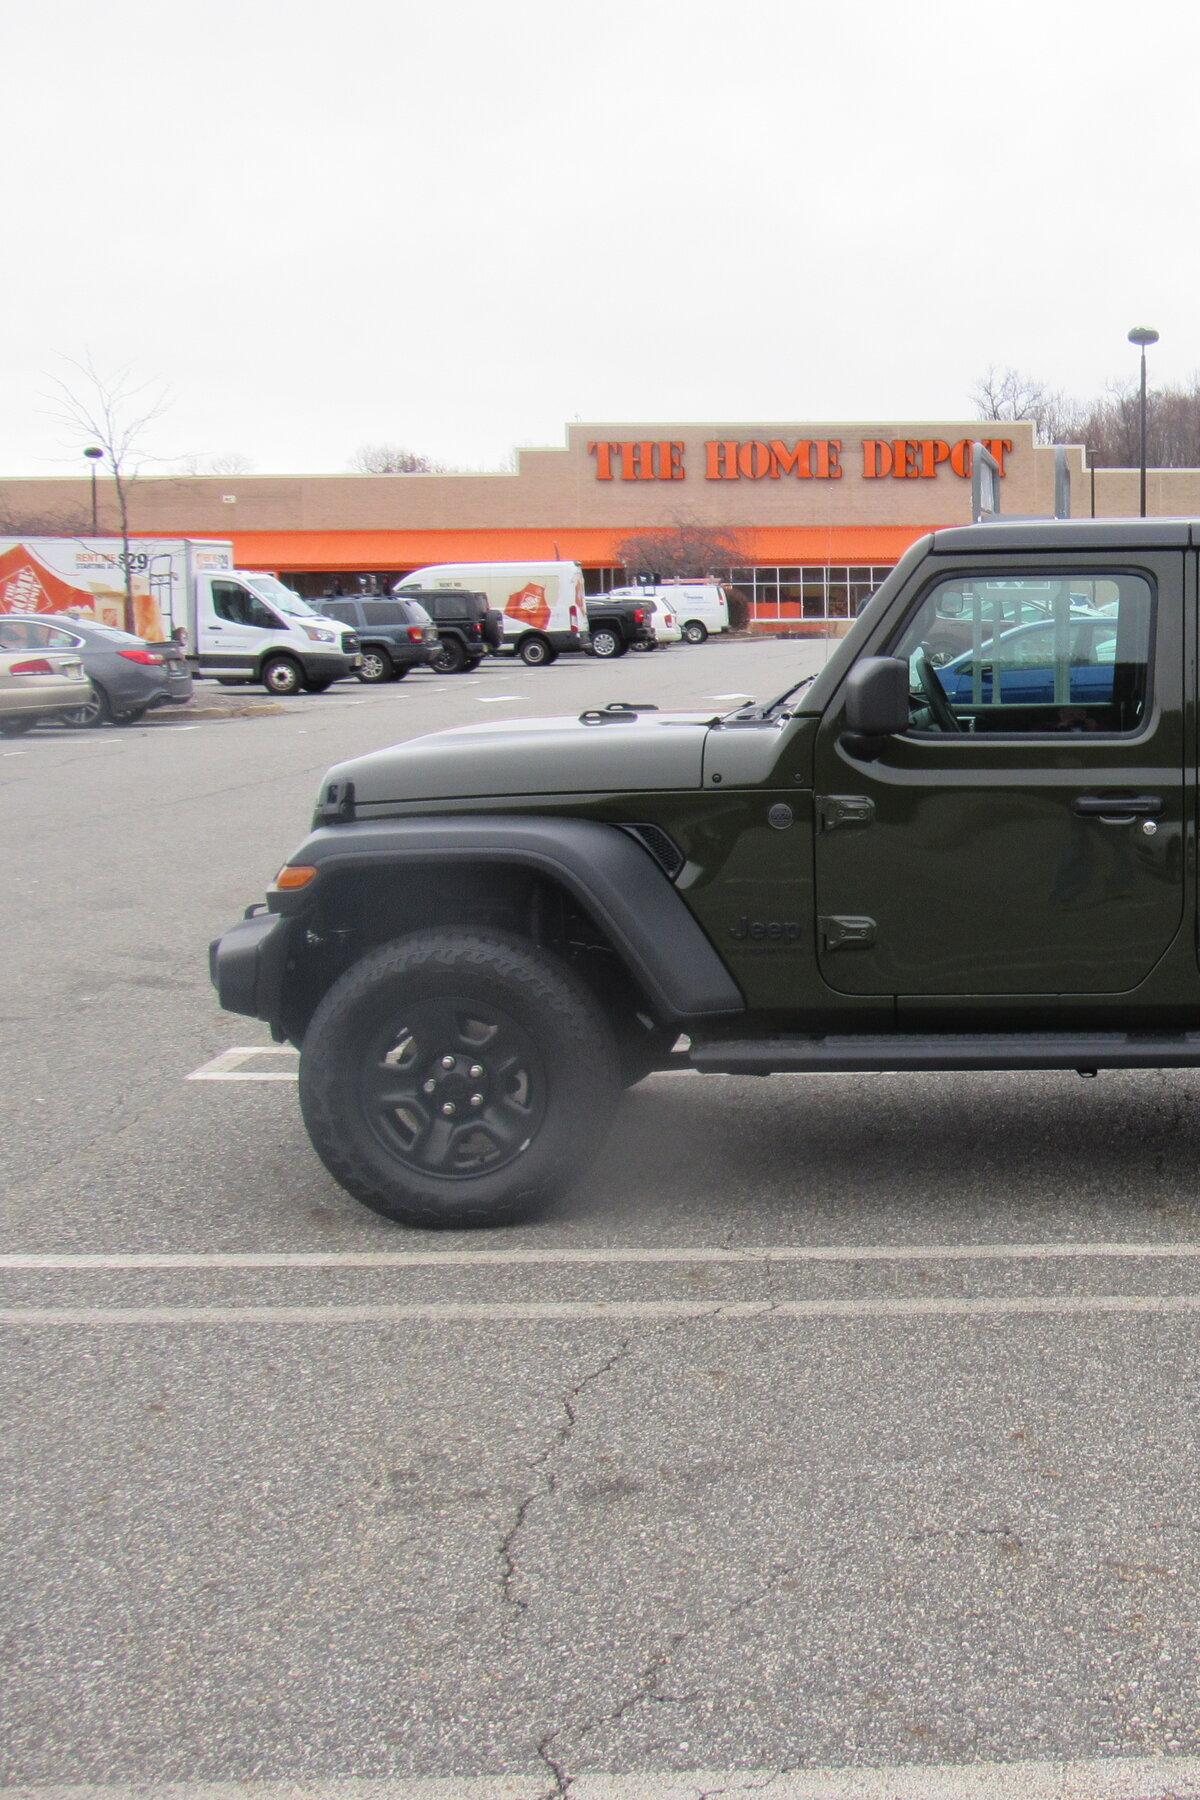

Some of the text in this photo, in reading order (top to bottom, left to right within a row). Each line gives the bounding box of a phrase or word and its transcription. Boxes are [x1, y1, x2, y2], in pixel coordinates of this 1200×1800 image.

[587, 438, 1013, 480] THE HOME DEPOT
[75, 553, 98, 563] RENT
[729, 916, 802, 945] Jeep
